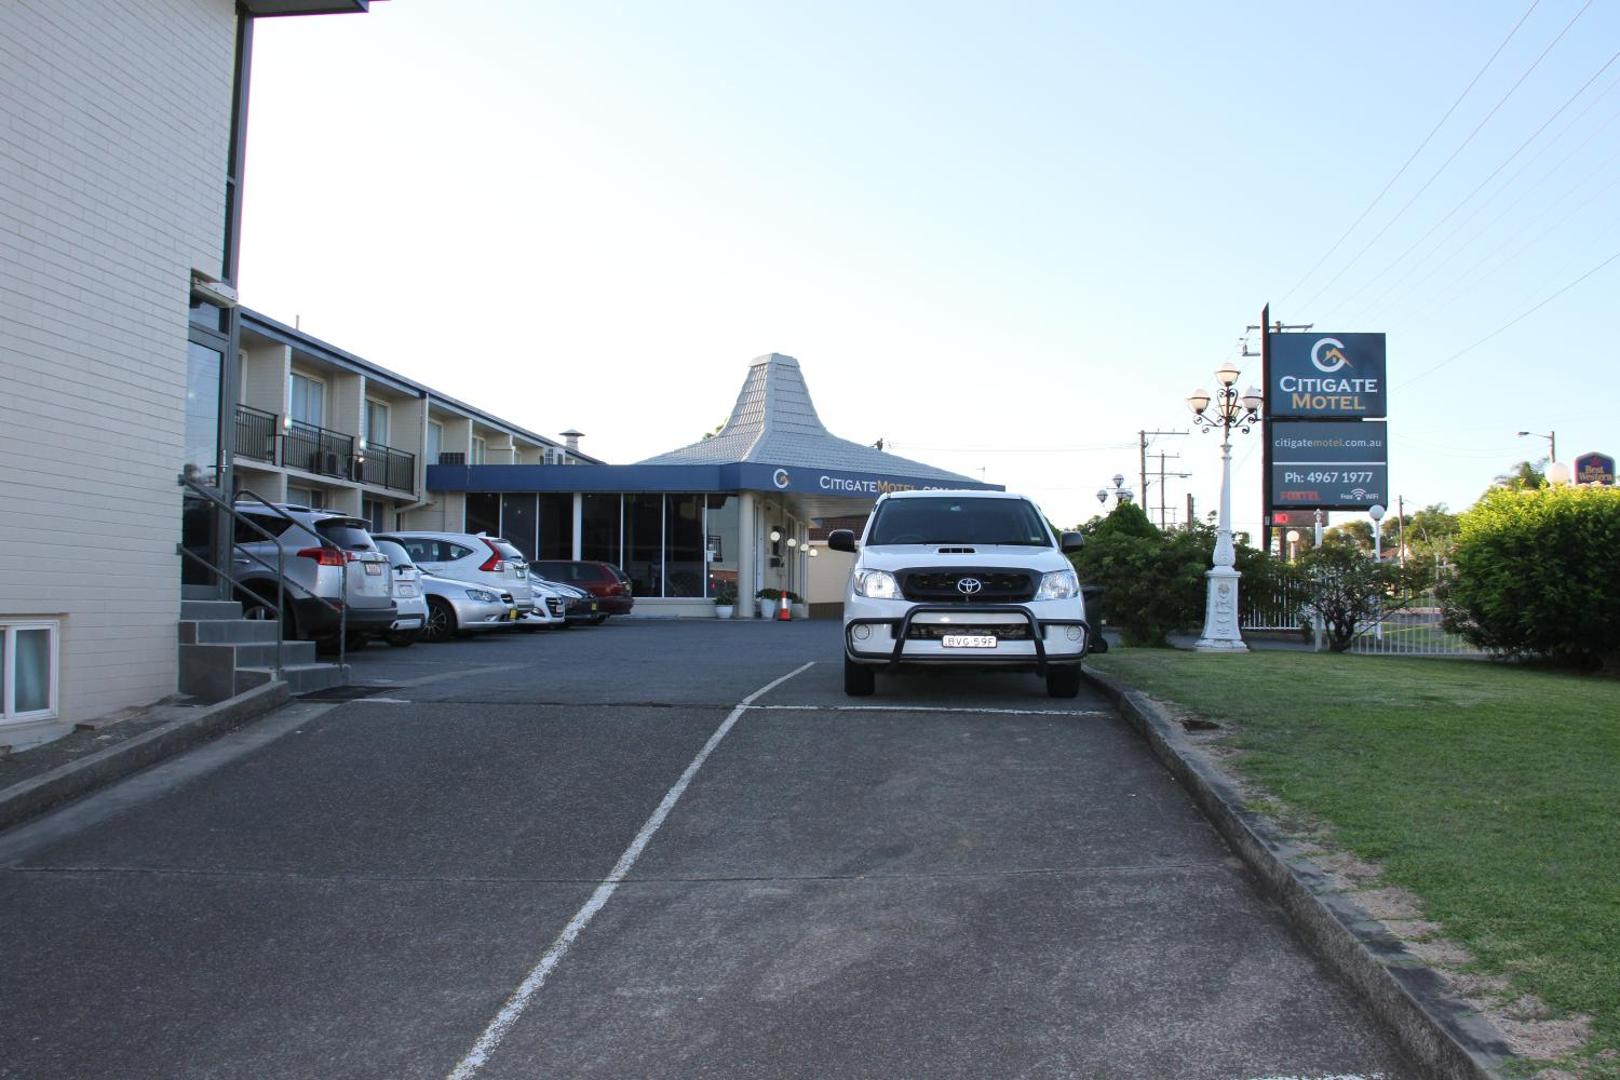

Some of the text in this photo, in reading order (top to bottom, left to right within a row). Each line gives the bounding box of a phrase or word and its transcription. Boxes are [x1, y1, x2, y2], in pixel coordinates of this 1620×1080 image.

[1280, 376, 1378, 393] CITIGATE
[1292, 393, 1366, 410] MOTEL
[1275, 438, 1382, 449] citigatemotel.com.au
[1284, 472, 1373, 483] Ph: 4967 1977
